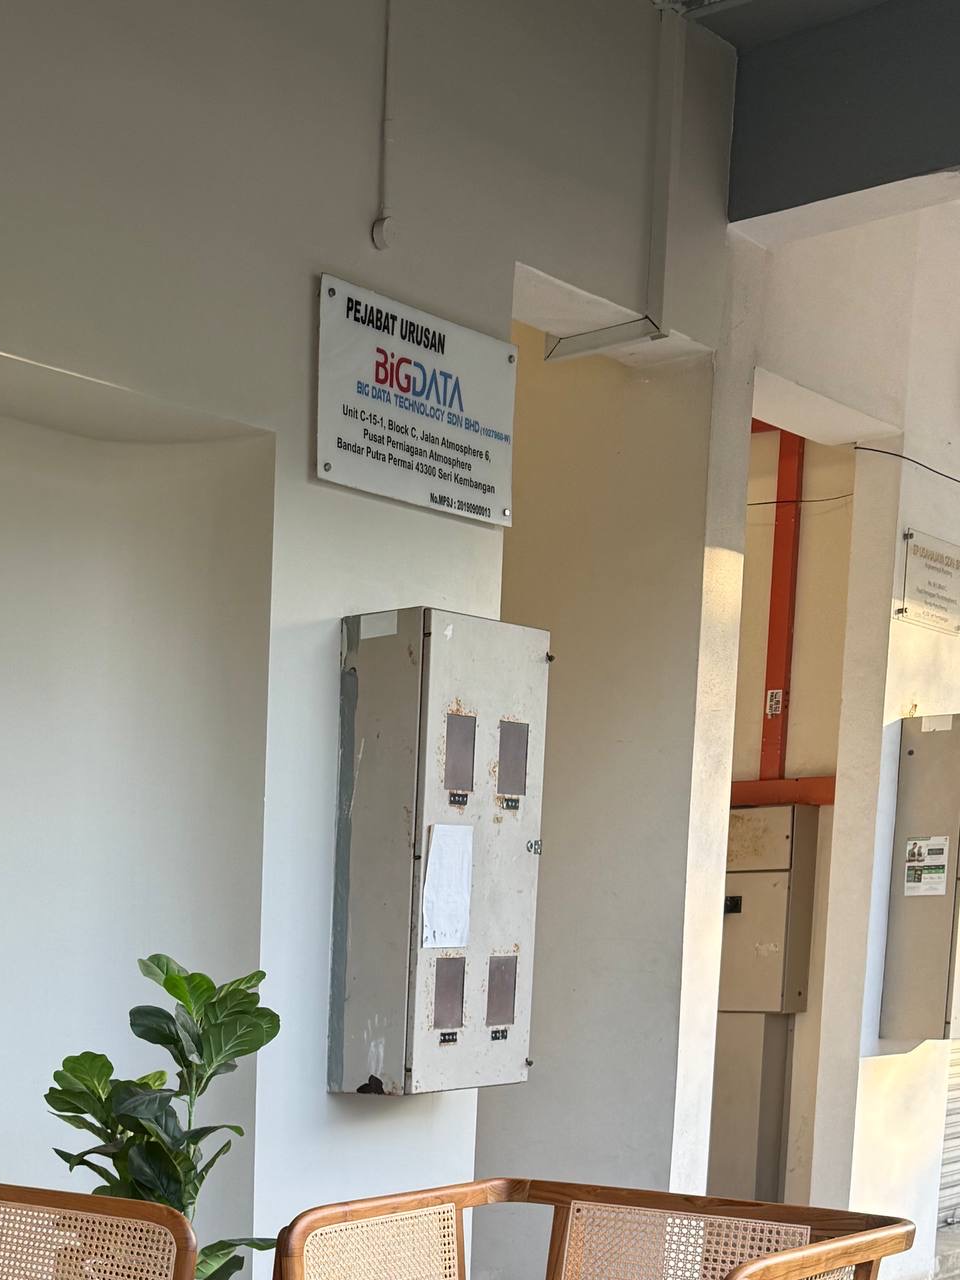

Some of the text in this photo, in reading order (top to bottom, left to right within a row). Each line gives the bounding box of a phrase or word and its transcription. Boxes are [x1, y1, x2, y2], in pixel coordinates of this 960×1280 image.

[346, 297, 446, 355] PEJABAT URUSAN
[342, 404, 491, 463] Unit C-15-1, Block C, Jalan Atmosphere 6,
[356, 380, 370, 396] BIG
[372, 384, 391, 404] DATA
[394, 394, 445, 422] TECHNOLOGY
[447, 412, 463, 428] SDN
[464, 416, 480, 433] BHD
[337, 437, 495, 494] Bandar Putra Permai 43300 Seri Kembangan
[363, 428, 472, 472] Pusat Perniagaan Atmosphere
